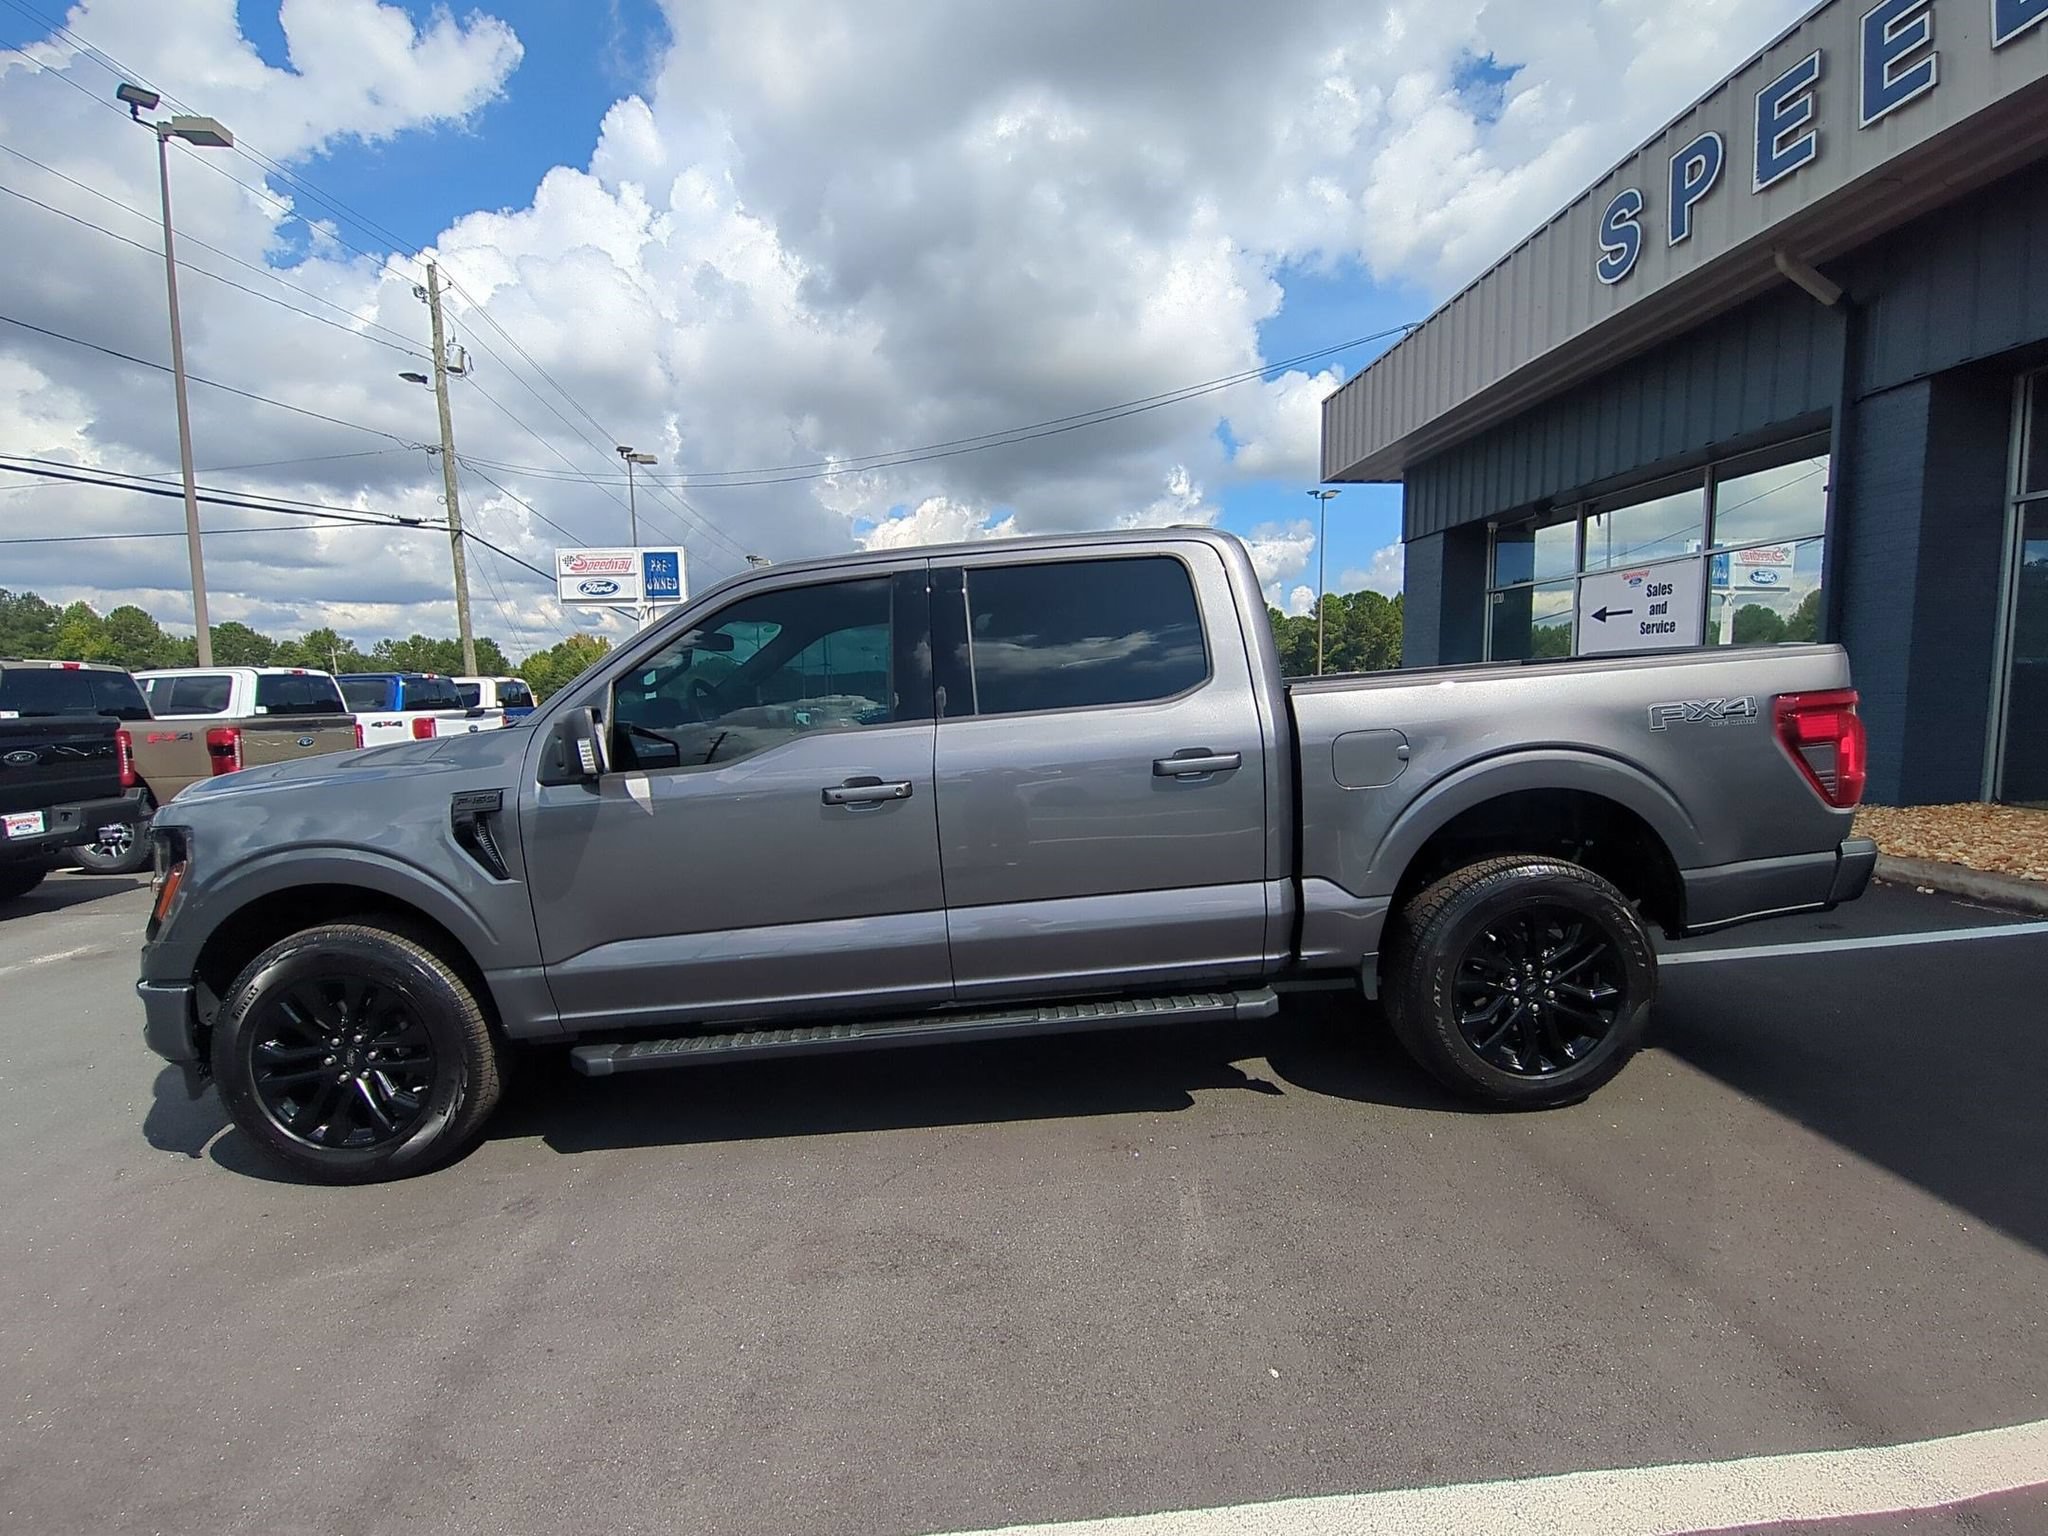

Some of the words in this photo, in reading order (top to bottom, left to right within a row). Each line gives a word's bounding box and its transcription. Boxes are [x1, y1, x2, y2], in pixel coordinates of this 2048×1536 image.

[1596, 0, 2048, 285] SPEE
[570, 554, 632, 573] Speedway
[650, 559, 671, 573] PRE-
[581, 580, 616, 594] Ford
[647, 577, 678, 591] OWNED
[1646, 582, 1673, 598] Sales
[1649, 600, 1668, 616] and
[1640, 620, 1676, 635] Service
[1648, 696, 1758, 733] FX4
